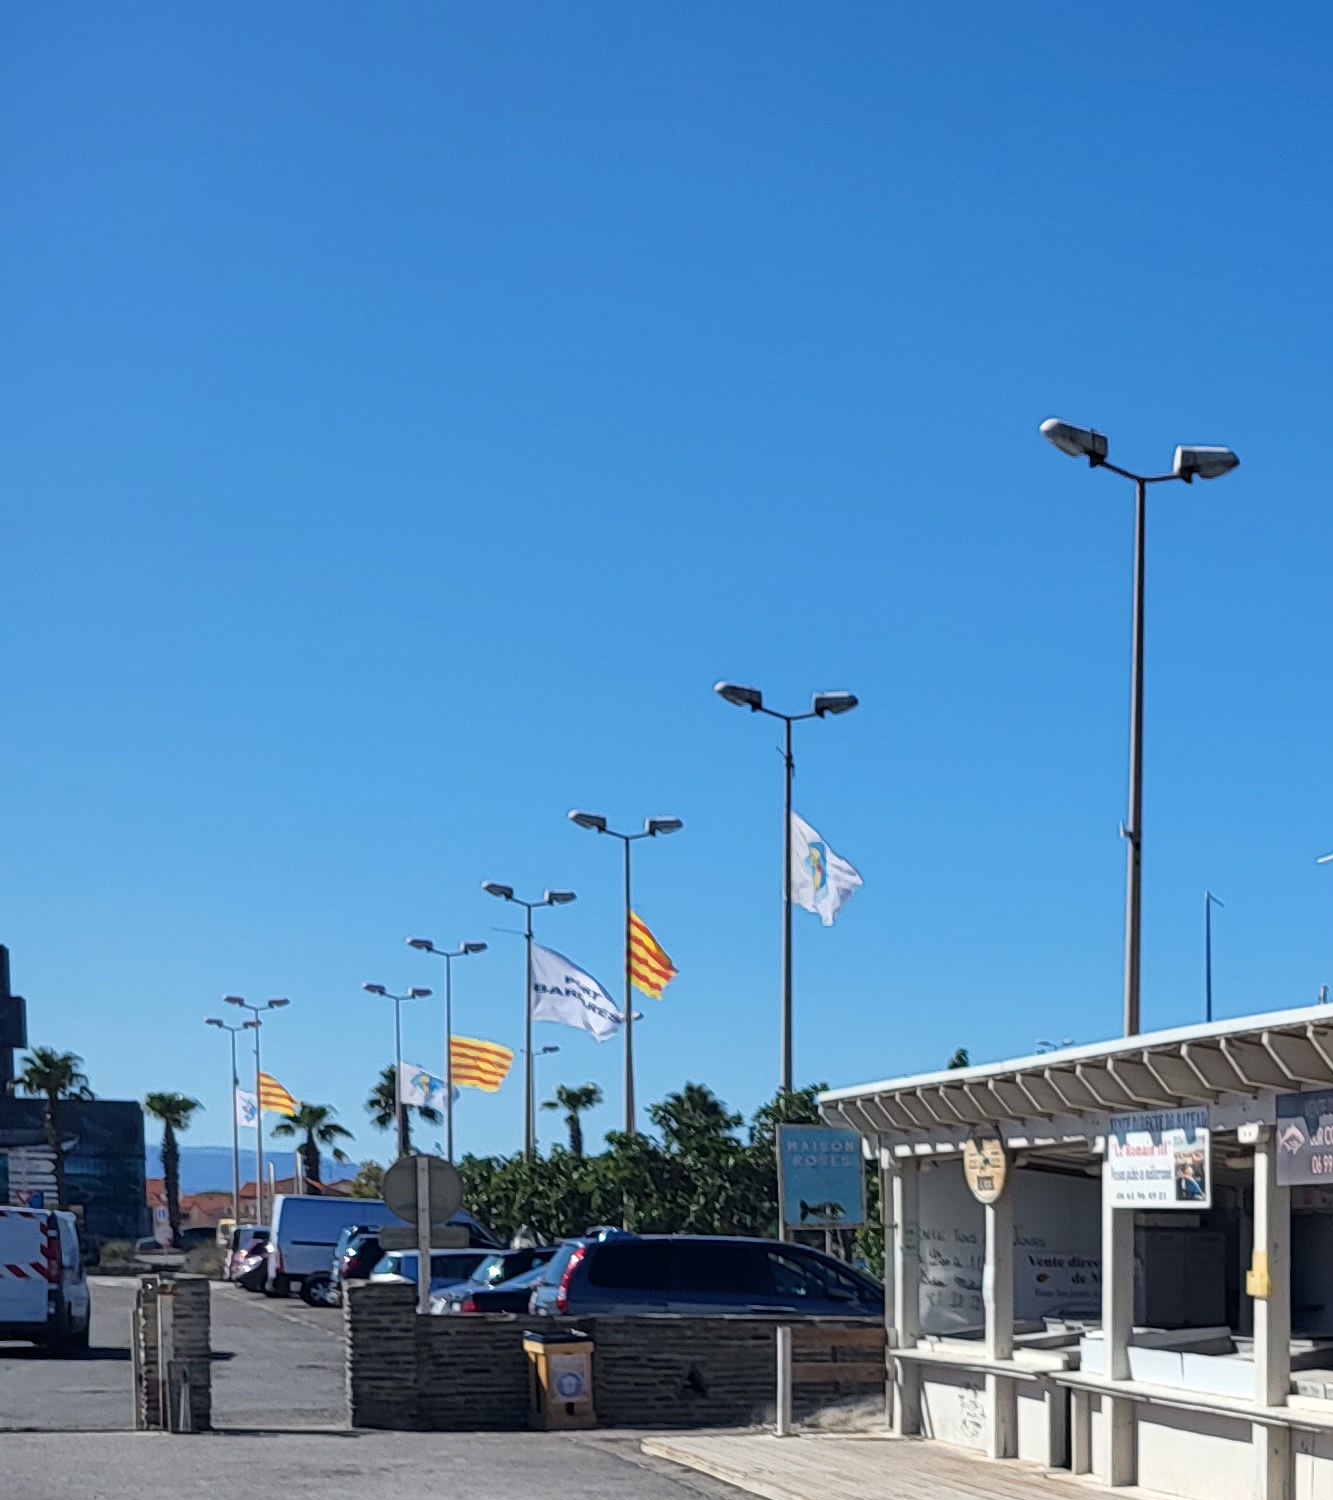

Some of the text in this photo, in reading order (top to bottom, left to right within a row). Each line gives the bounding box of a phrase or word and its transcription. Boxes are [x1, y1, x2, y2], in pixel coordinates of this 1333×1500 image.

[787, 1141, 854, 1153] MAISON
[1311, 1154, 1322, 1174] 06
[1323, 1153, 1333, 1173] 99
[1028, 1255, 1065, 1269] Vente
[1071, 1271, 1087, 1285] de
